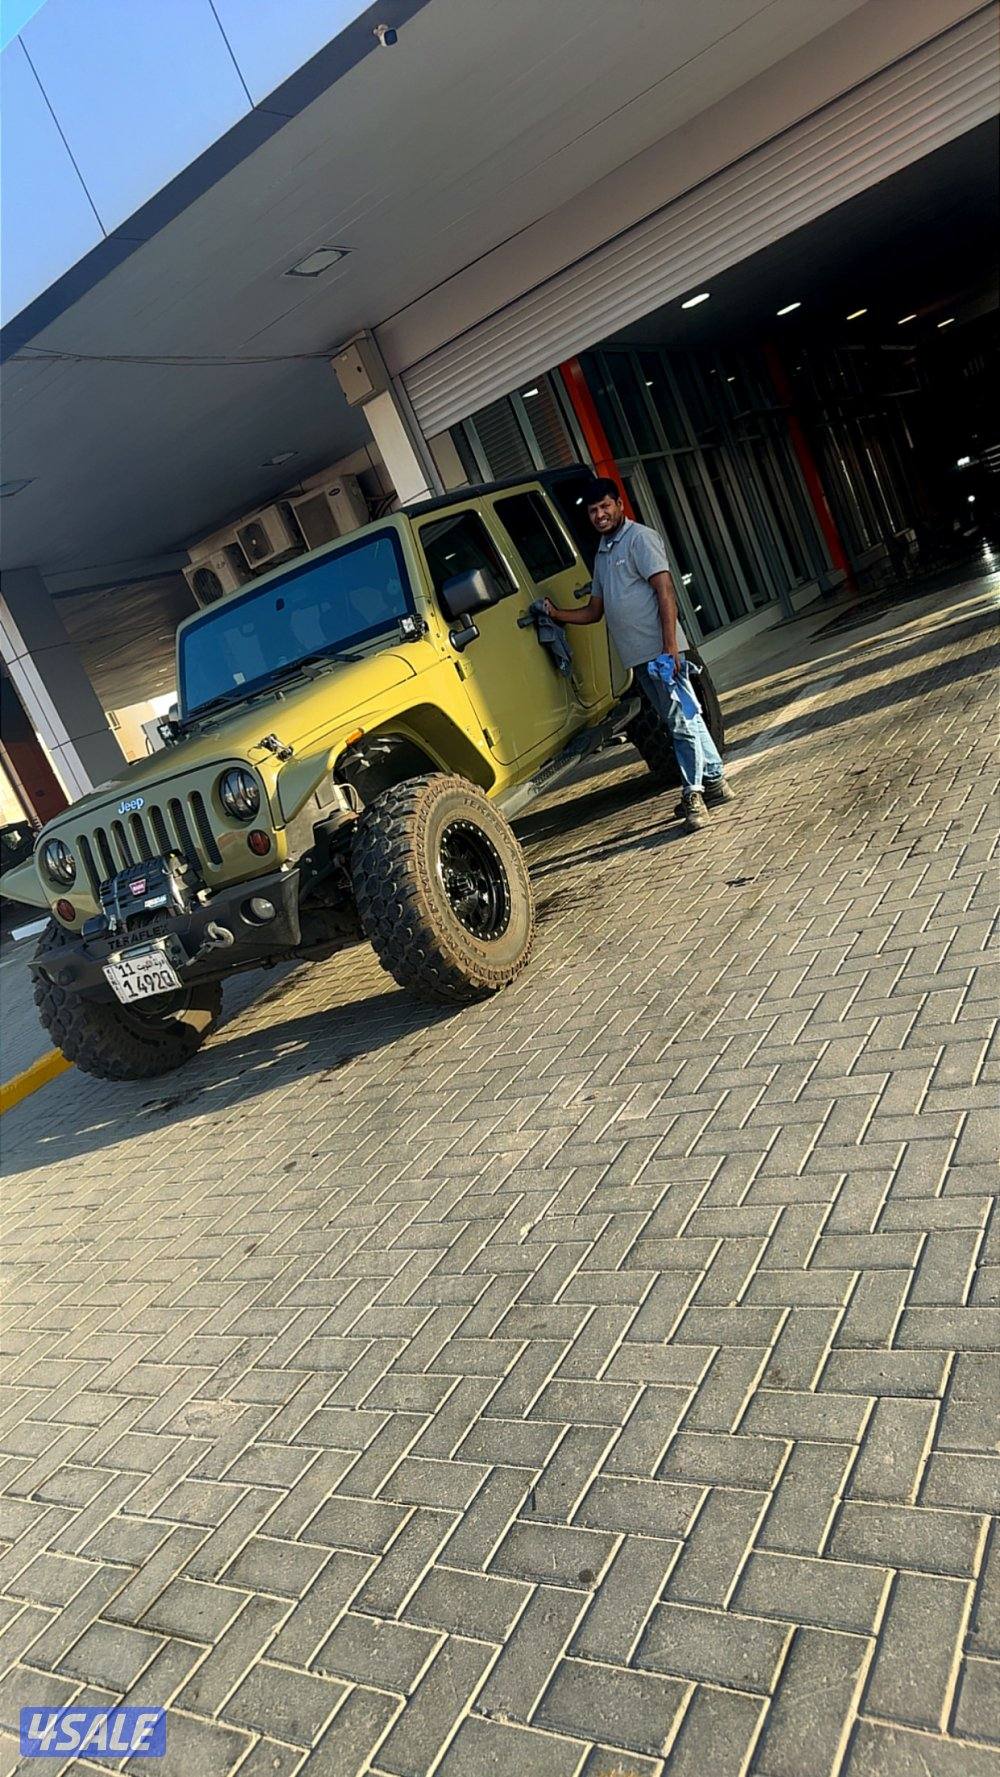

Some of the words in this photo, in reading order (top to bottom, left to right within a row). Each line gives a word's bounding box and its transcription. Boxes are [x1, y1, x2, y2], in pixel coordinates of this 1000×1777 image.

[118, 798, 144, 814] Jeep
[108, 926, 168, 950] TERAFLEX
[118, 963, 135, 977] 11
[124, 970, 175, 998] 14920
